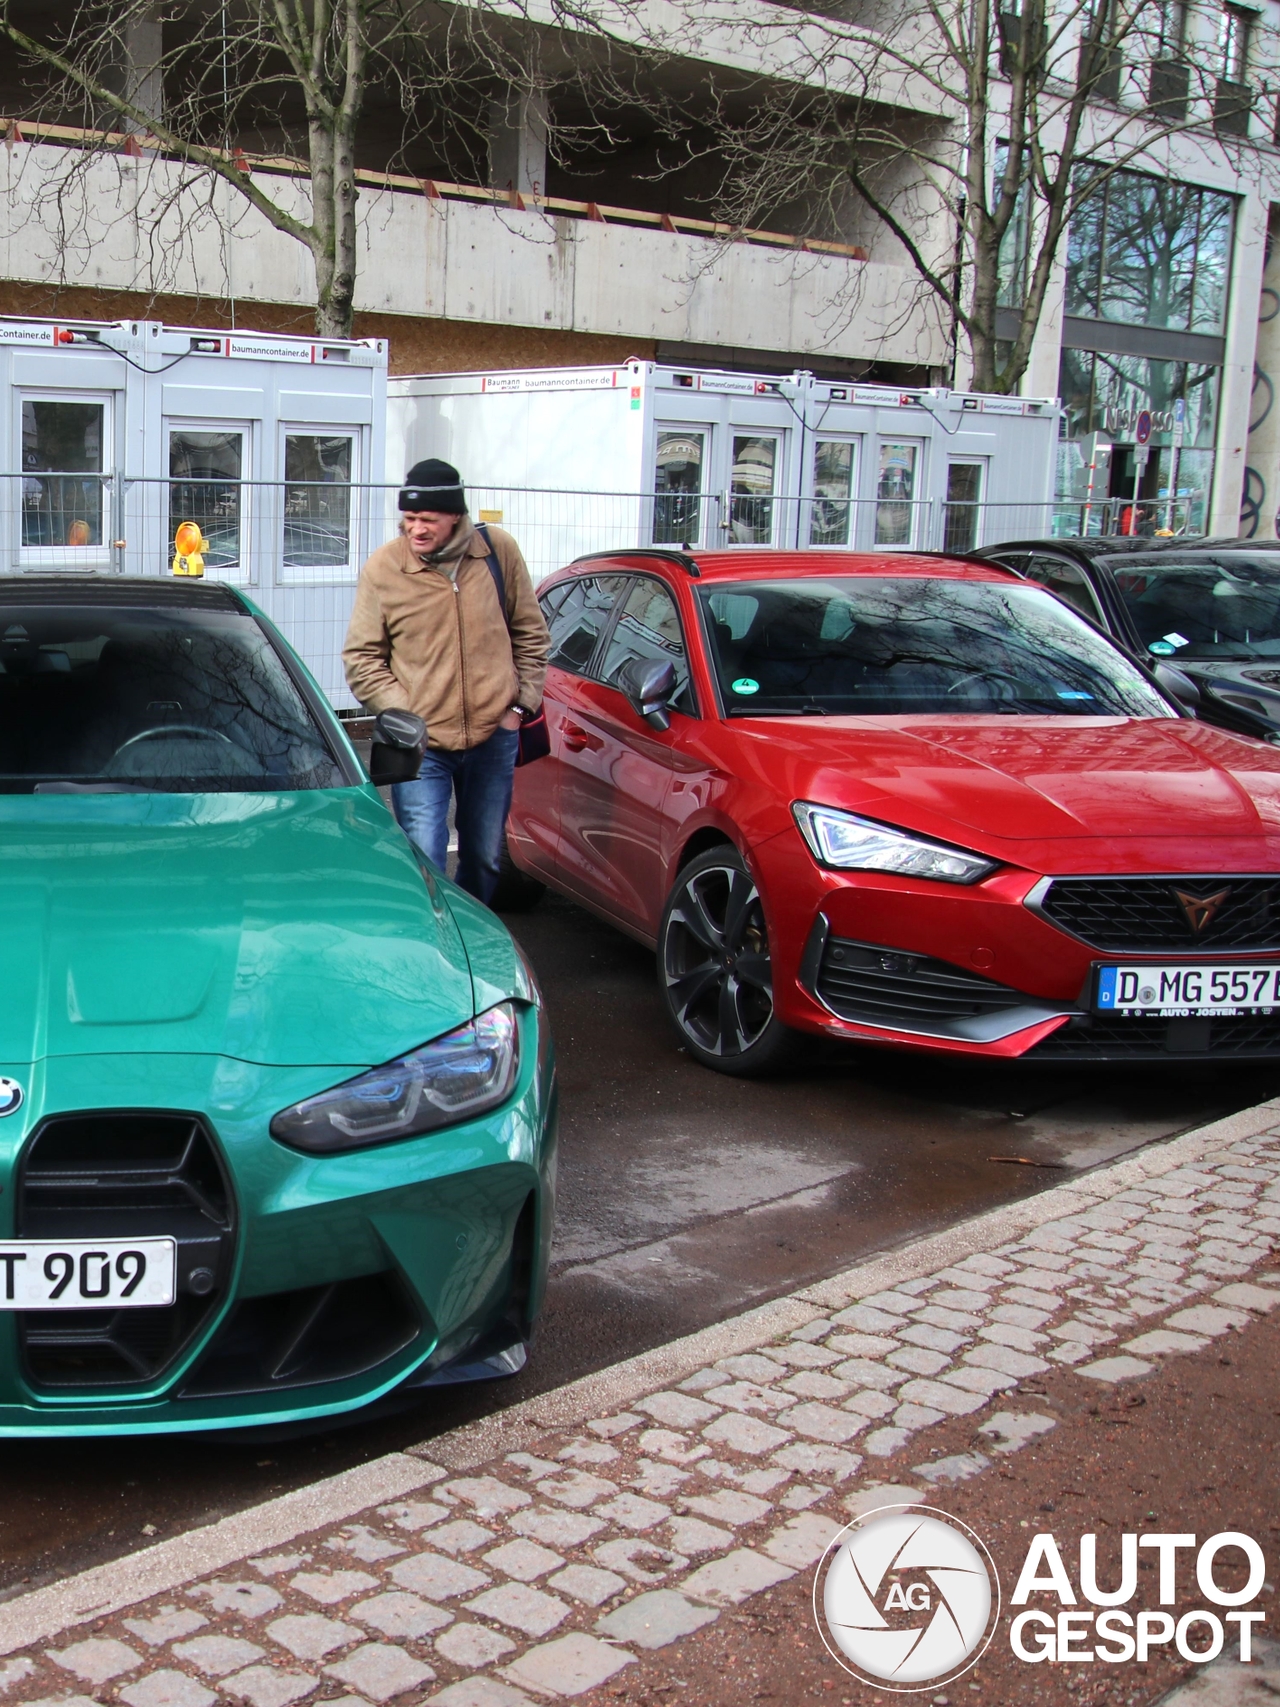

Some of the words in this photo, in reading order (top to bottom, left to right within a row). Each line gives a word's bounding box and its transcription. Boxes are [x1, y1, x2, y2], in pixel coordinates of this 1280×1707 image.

[232, 343, 309, 358] baumanncontainer.de
[487, 379, 520, 387] Baumann
[525, 376, 611, 387] baumanncontainer.de
[702, 380, 754, 391] BaumannContainer.de
[1118, 971, 1139, 1003] D
[1159, 971, 1202, 1003] MG
[1102, 992, 1110, 1002] D
[43, 1250, 147, 1299] 909
